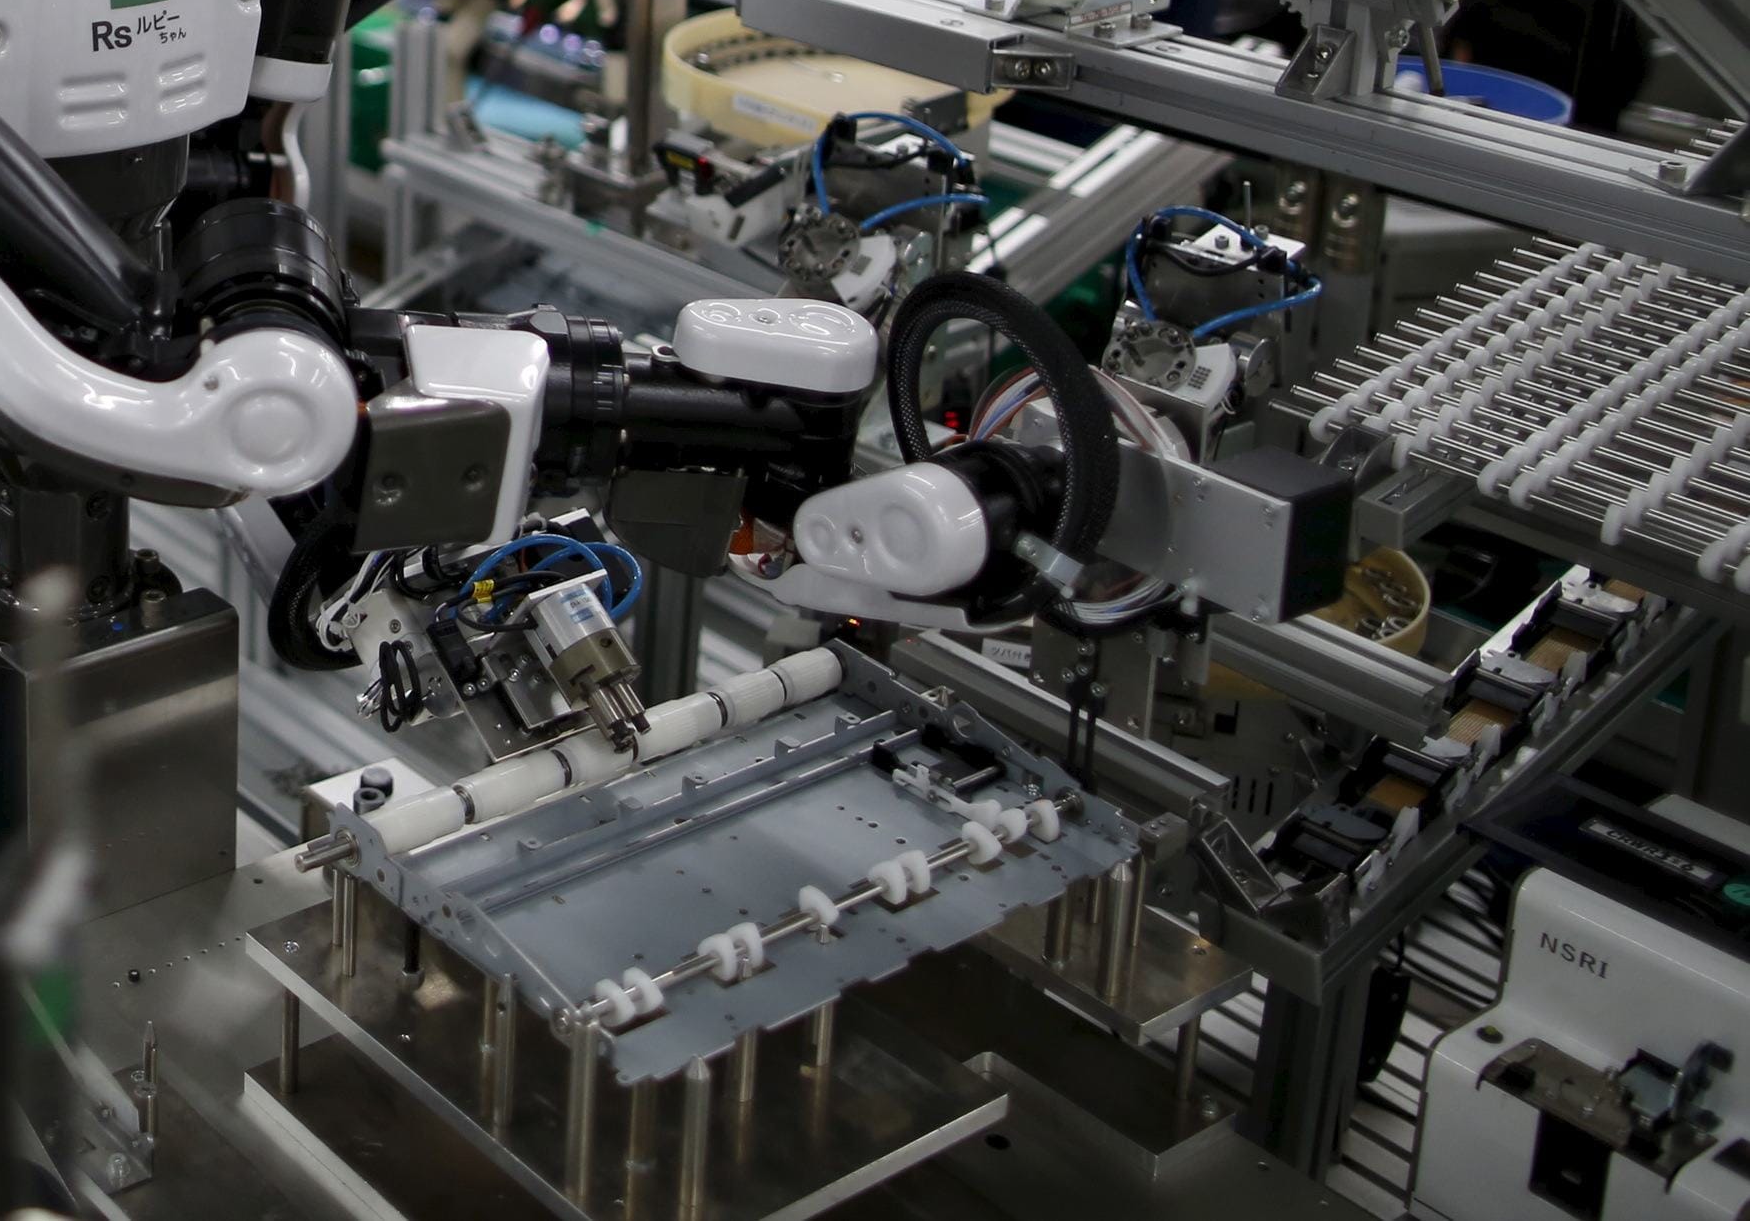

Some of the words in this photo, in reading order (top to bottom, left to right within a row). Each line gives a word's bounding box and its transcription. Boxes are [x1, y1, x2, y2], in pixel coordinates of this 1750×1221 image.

[91, 20, 133, 53] Rs
[136, 10, 180, 35] ルピー
[158, 27, 187, 44] ちゃん
[1539, 931, 1610, 980] NSRI
